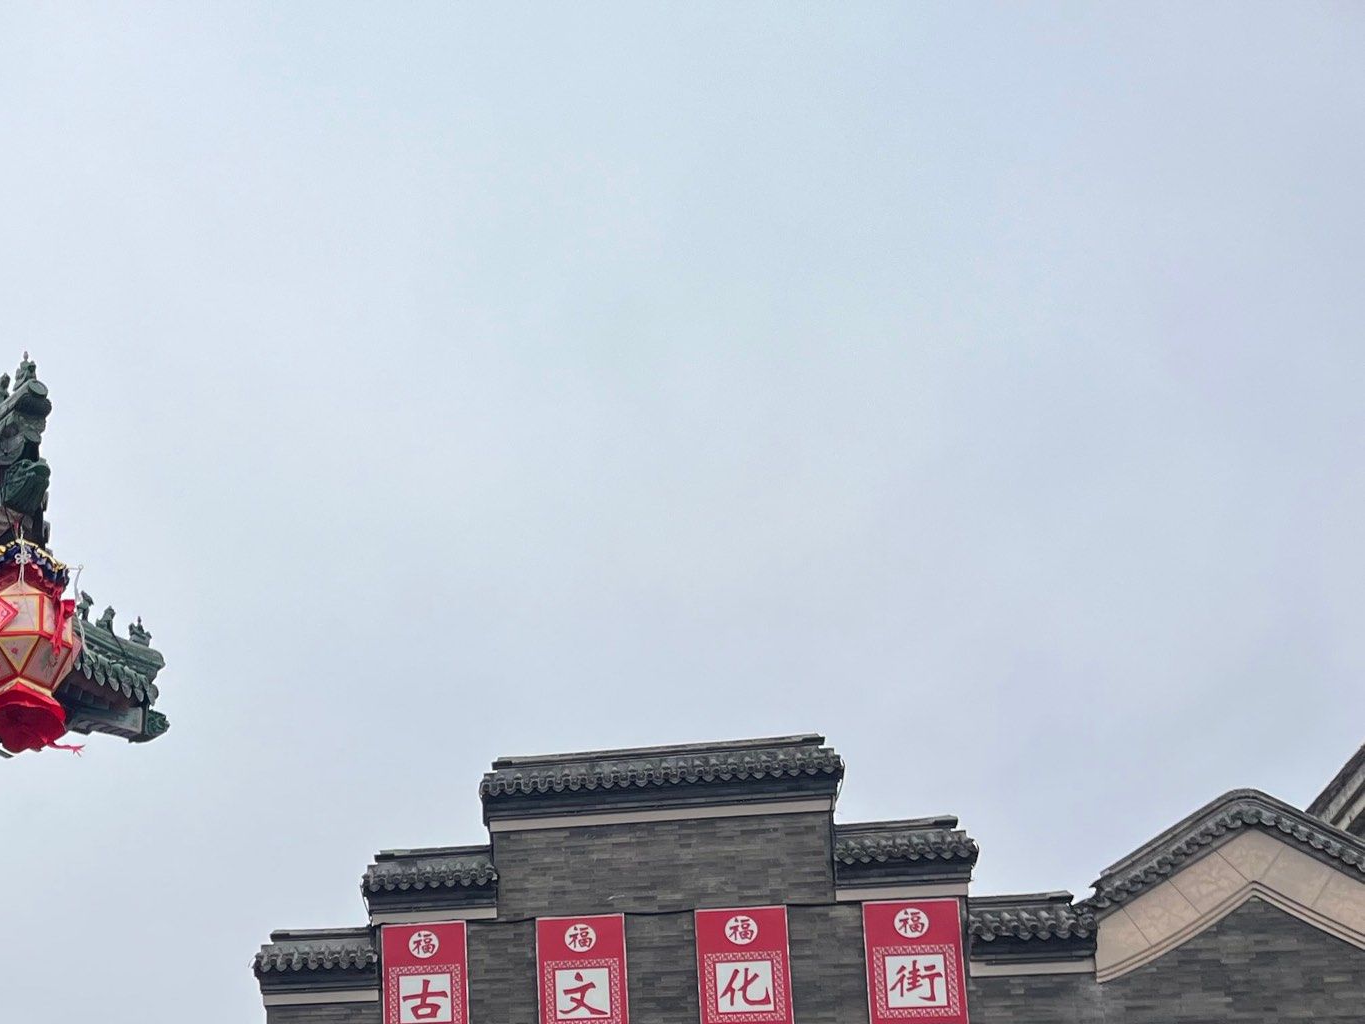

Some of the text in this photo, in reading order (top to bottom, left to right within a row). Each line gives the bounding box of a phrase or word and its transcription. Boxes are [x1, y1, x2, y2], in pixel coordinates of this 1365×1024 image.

[567, 925, 593, 949] 福
[728, 917, 755, 941] 福
[897, 910, 925, 934] 福
[412, 931, 436, 955] 福
[558, 971, 609, 1016] 文
[719, 967, 772, 1007] 化
[888, 958, 944, 1002] 街
[401, 979, 449, 1020] 古
